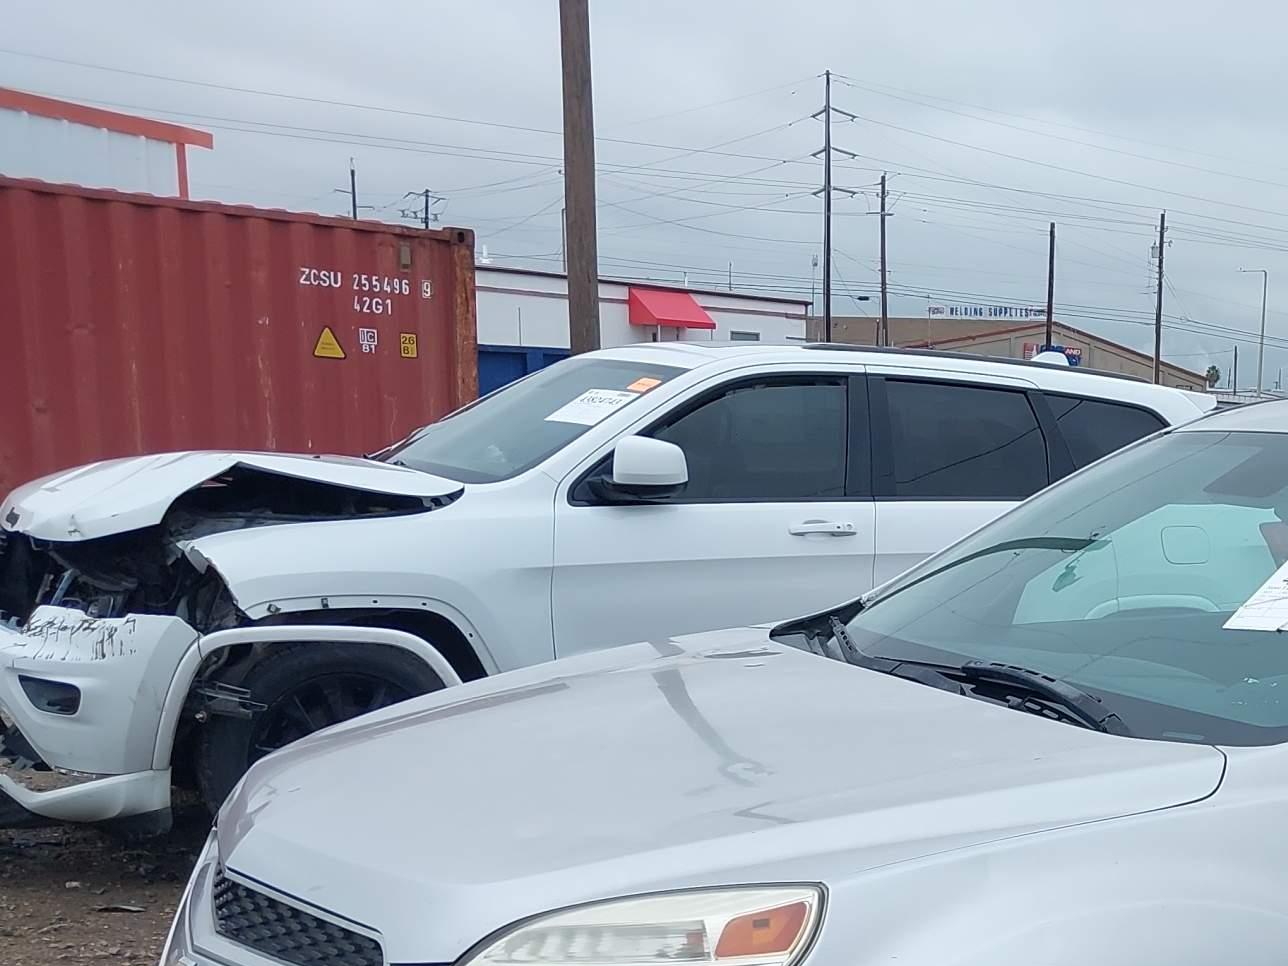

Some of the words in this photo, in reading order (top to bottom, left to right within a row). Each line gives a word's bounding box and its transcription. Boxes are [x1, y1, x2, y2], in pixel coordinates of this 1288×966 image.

[300, 267, 342, 288] ZCSU
[352, 274, 410, 295] 255496
[423, 281, 431, 297] 9
[353, 296, 392, 315] 42G1
[950, 306, 983, 317] WELDING
[988, 306, 1029, 318] SUPPLIES
